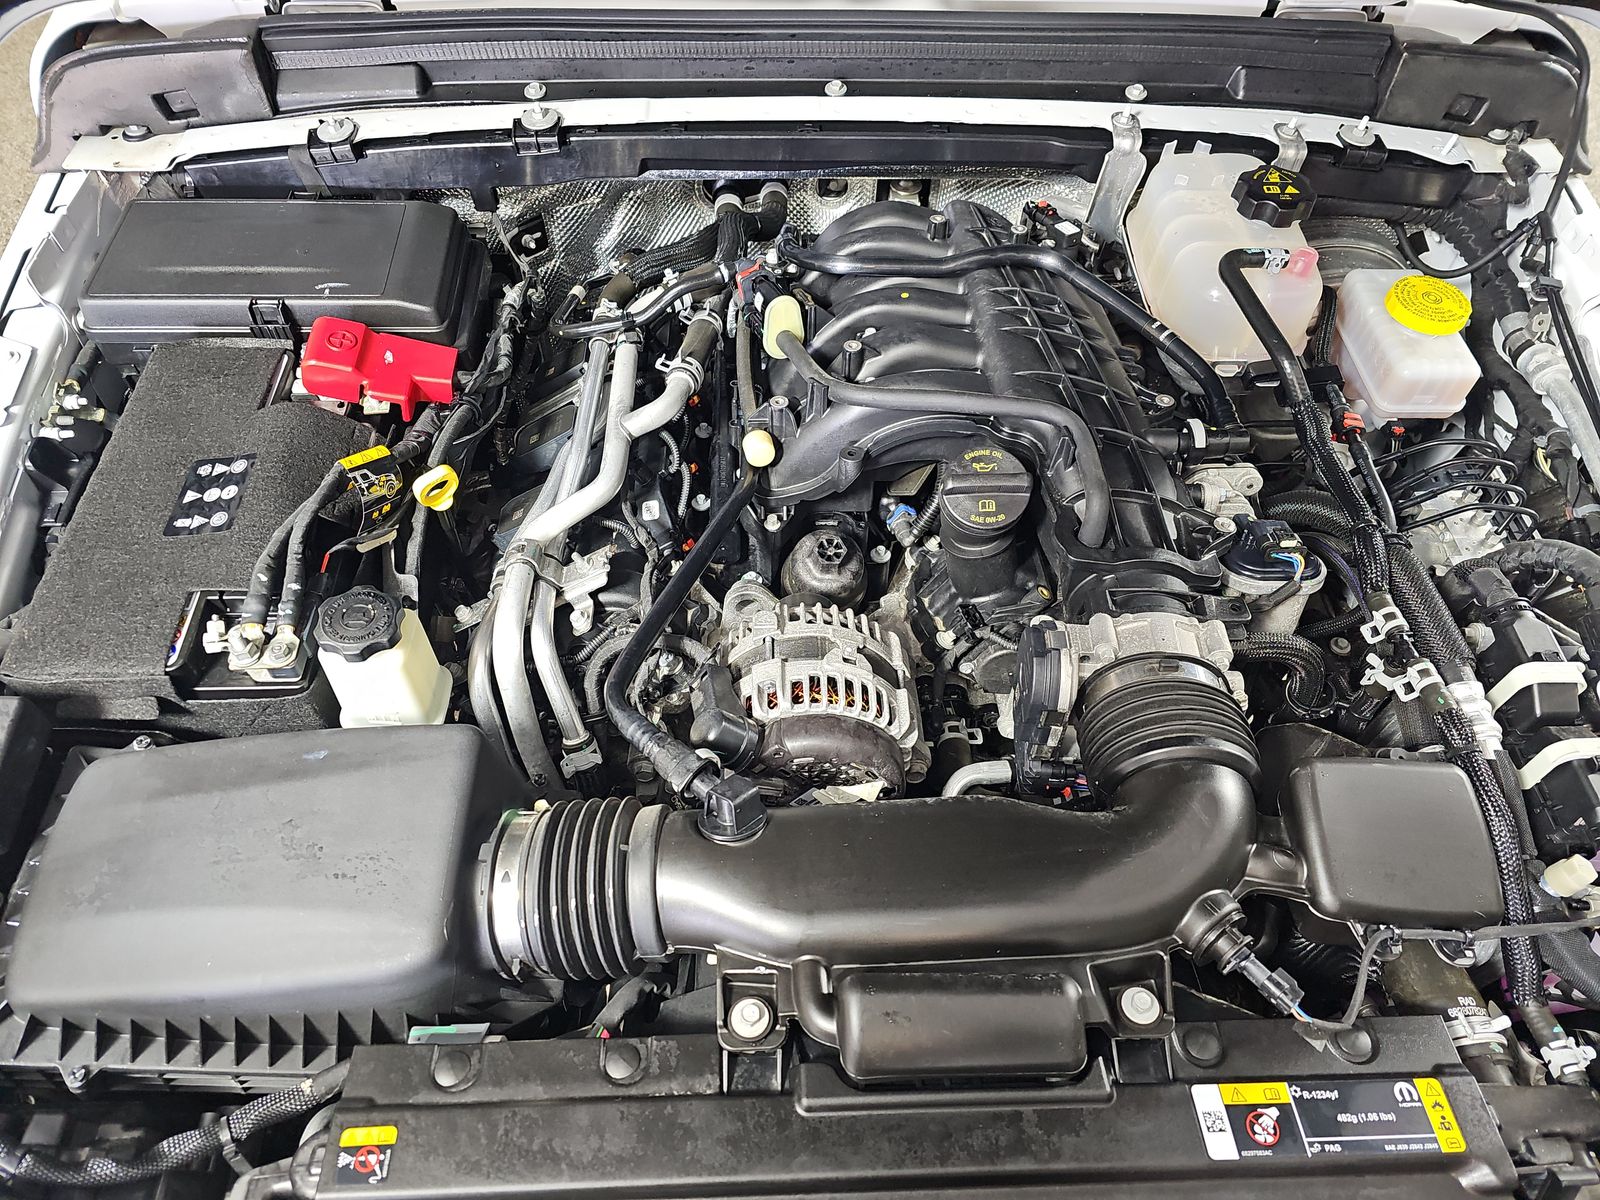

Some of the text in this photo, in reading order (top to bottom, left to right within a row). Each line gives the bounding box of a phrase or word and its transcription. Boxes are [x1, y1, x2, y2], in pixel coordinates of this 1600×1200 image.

[964, 449, 1003, 460] ENGINE OIL
[970, 513, 1006, 524] SAE 0W-20
[1457, 996, 1476, 1006] RAD
[1302, 1089, 1339, 1101] R-1234yf
[1337, 1111, 1397, 1124] 482g (1.06 lbs)
[1324, 1143, 1342, 1153] PAG
